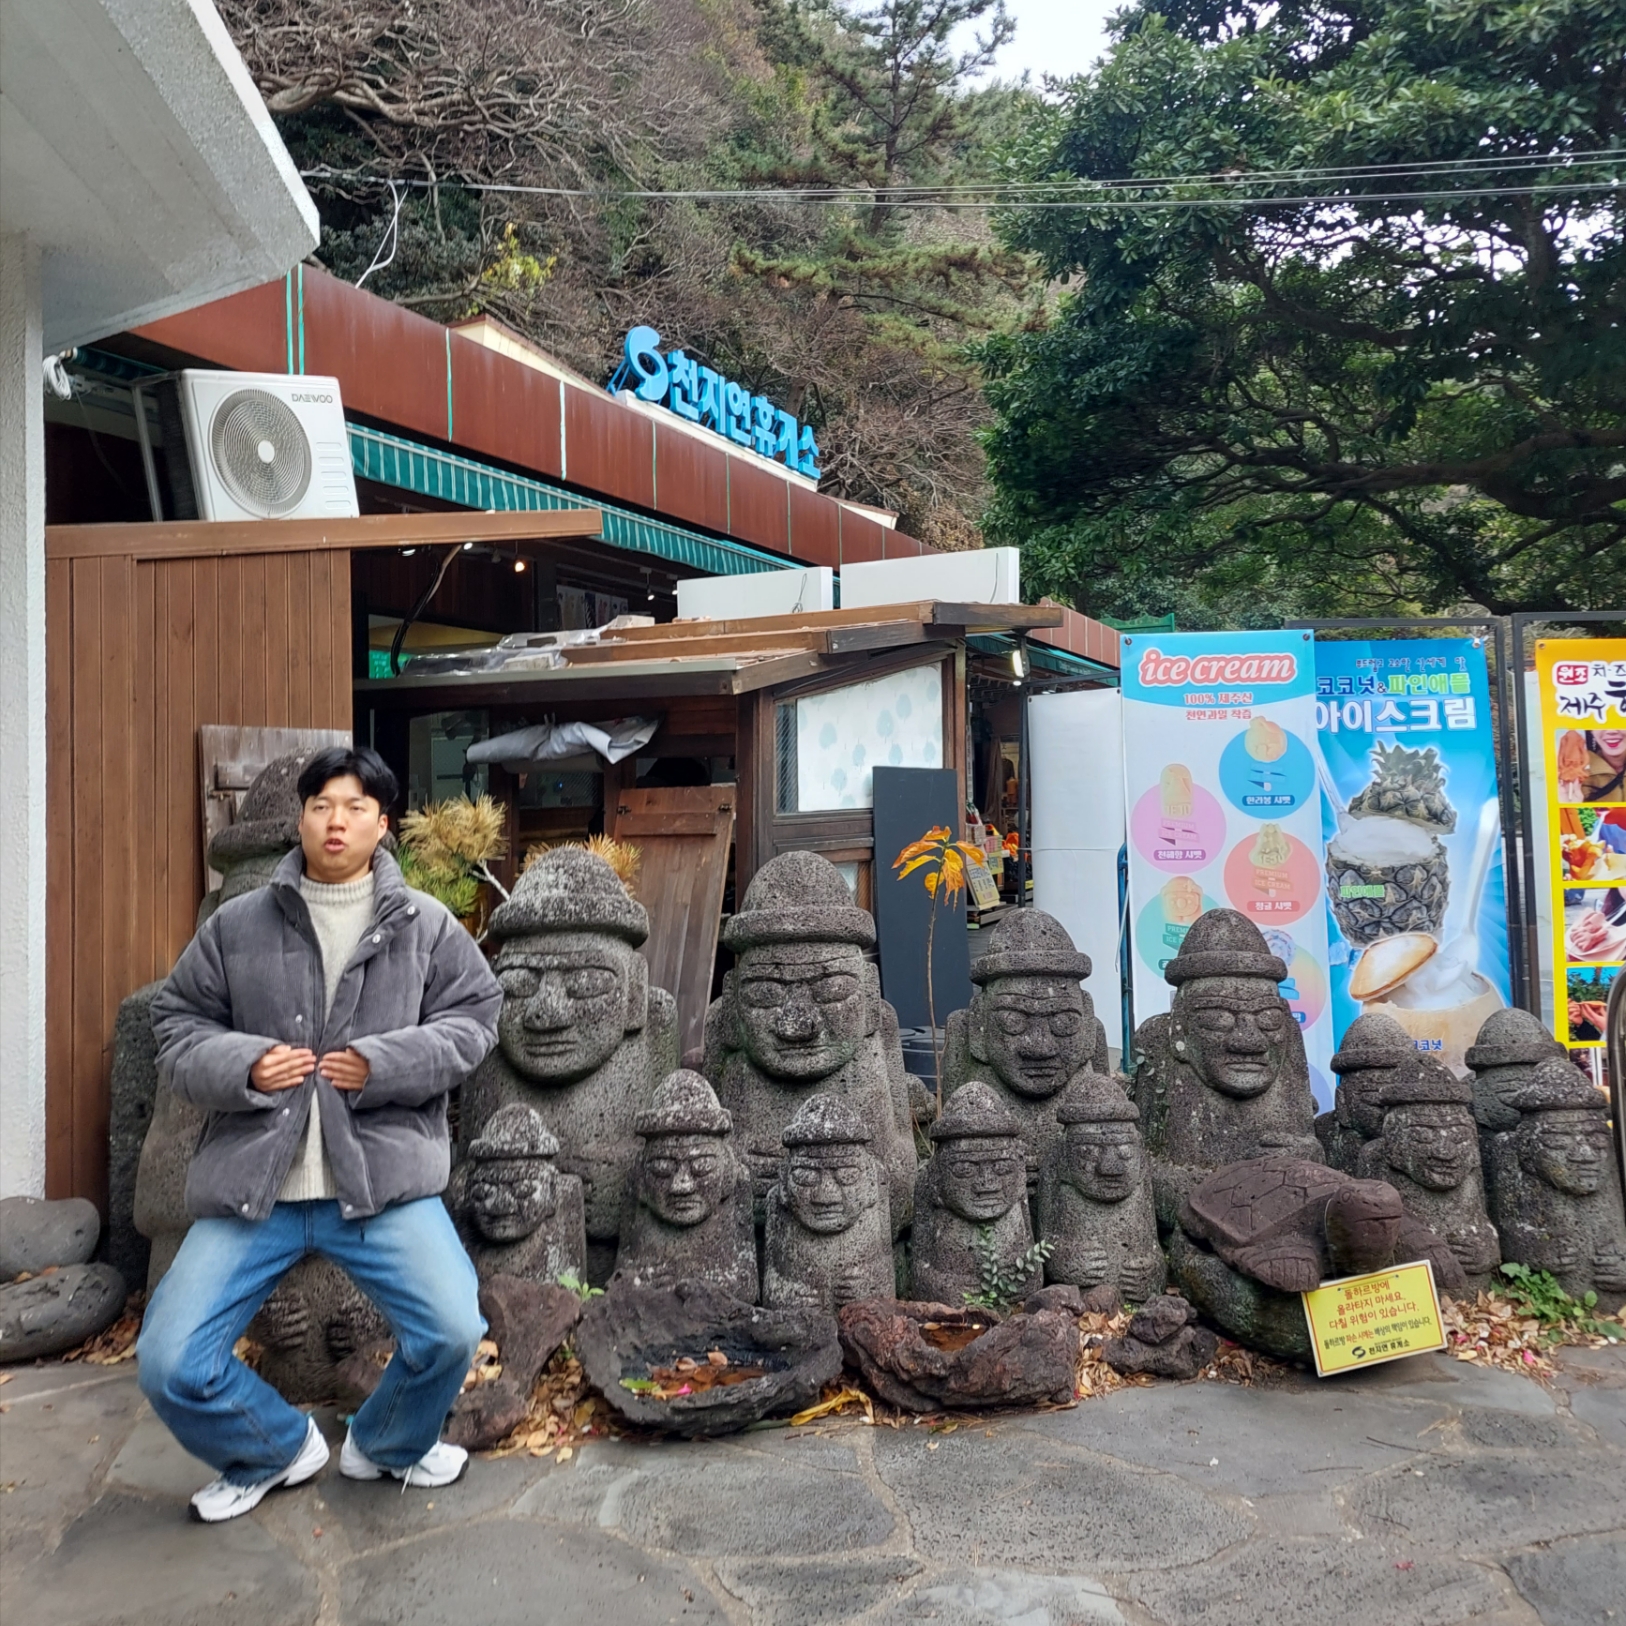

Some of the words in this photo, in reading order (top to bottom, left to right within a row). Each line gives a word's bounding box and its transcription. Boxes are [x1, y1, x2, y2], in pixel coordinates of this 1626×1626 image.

[291, 393, 333, 404] DAEWOO
[1144, 652, 1187, 681] ice
[1194, 658, 1292, 680] cream
[1558, 666, 1587, 684] 원조
[1185, 693, 1215, 704] 100%
[1218, 693, 1253, 703] 제주산
[1559, 691, 1607, 720] 제주
[1186, 710, 1228, 720] 천연과일
[1314, 698, 1477, 733] 아이스크림
[1344, 1280, 1389, 1300] 돌하르방에
[1336, 1298, 1373, 1315] 올라타지
[1375, 1290, 1406, 1305] 마세요.
[1329, 1318, 1347, 1330] 다칠
[1349, 1312, 1377, 1326] 위험이
[1379, 1301, 1419, 1318] 있습니다.
[1368, 1343, 1388, 1355] 천지연
